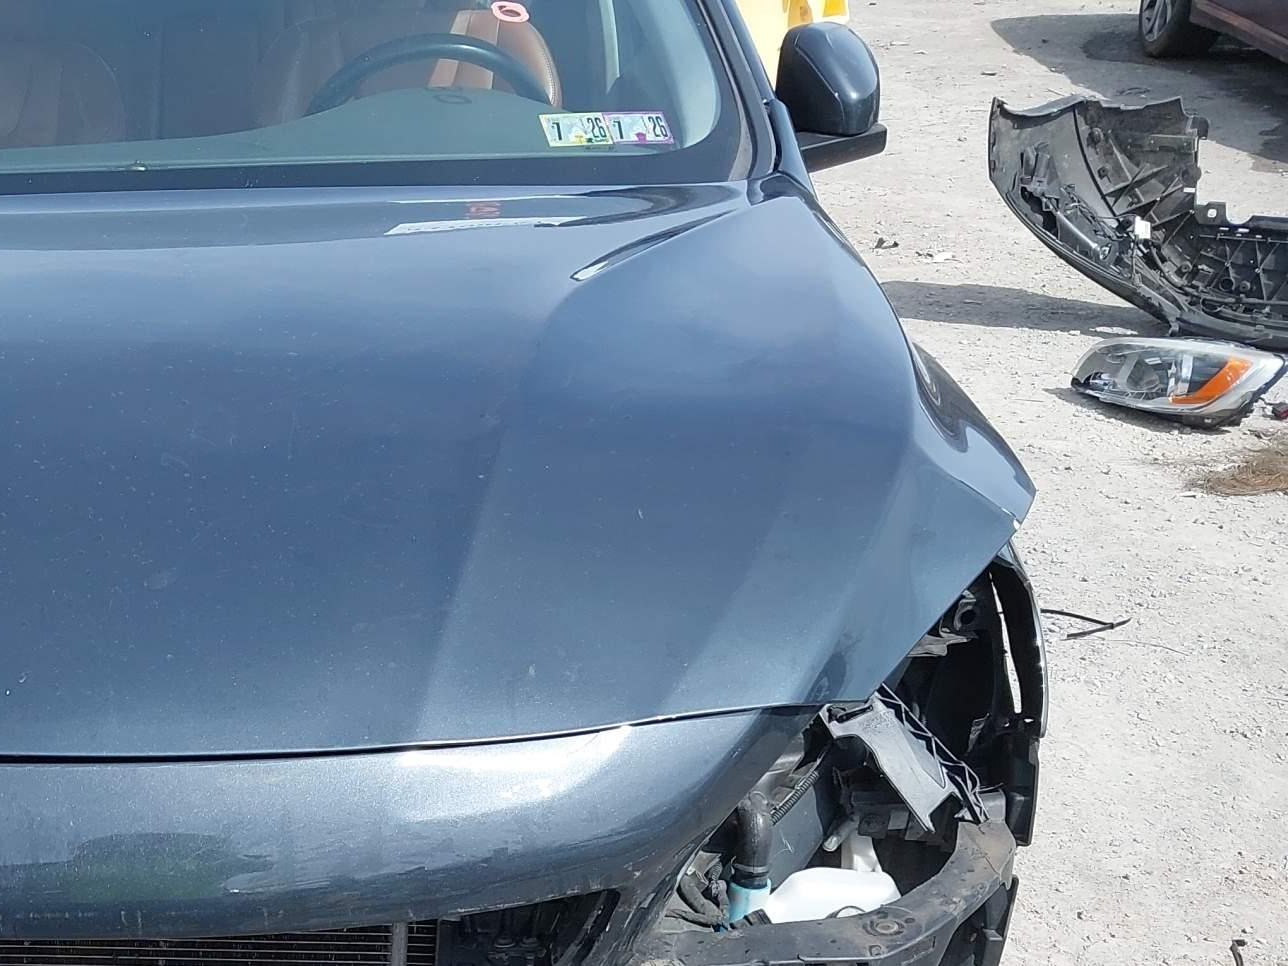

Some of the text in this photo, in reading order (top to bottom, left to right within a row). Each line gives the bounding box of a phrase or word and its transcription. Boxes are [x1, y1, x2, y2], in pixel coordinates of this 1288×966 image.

[551, 117, 608, 141] 7 26
[612, 115, 669, 140] 7 26
